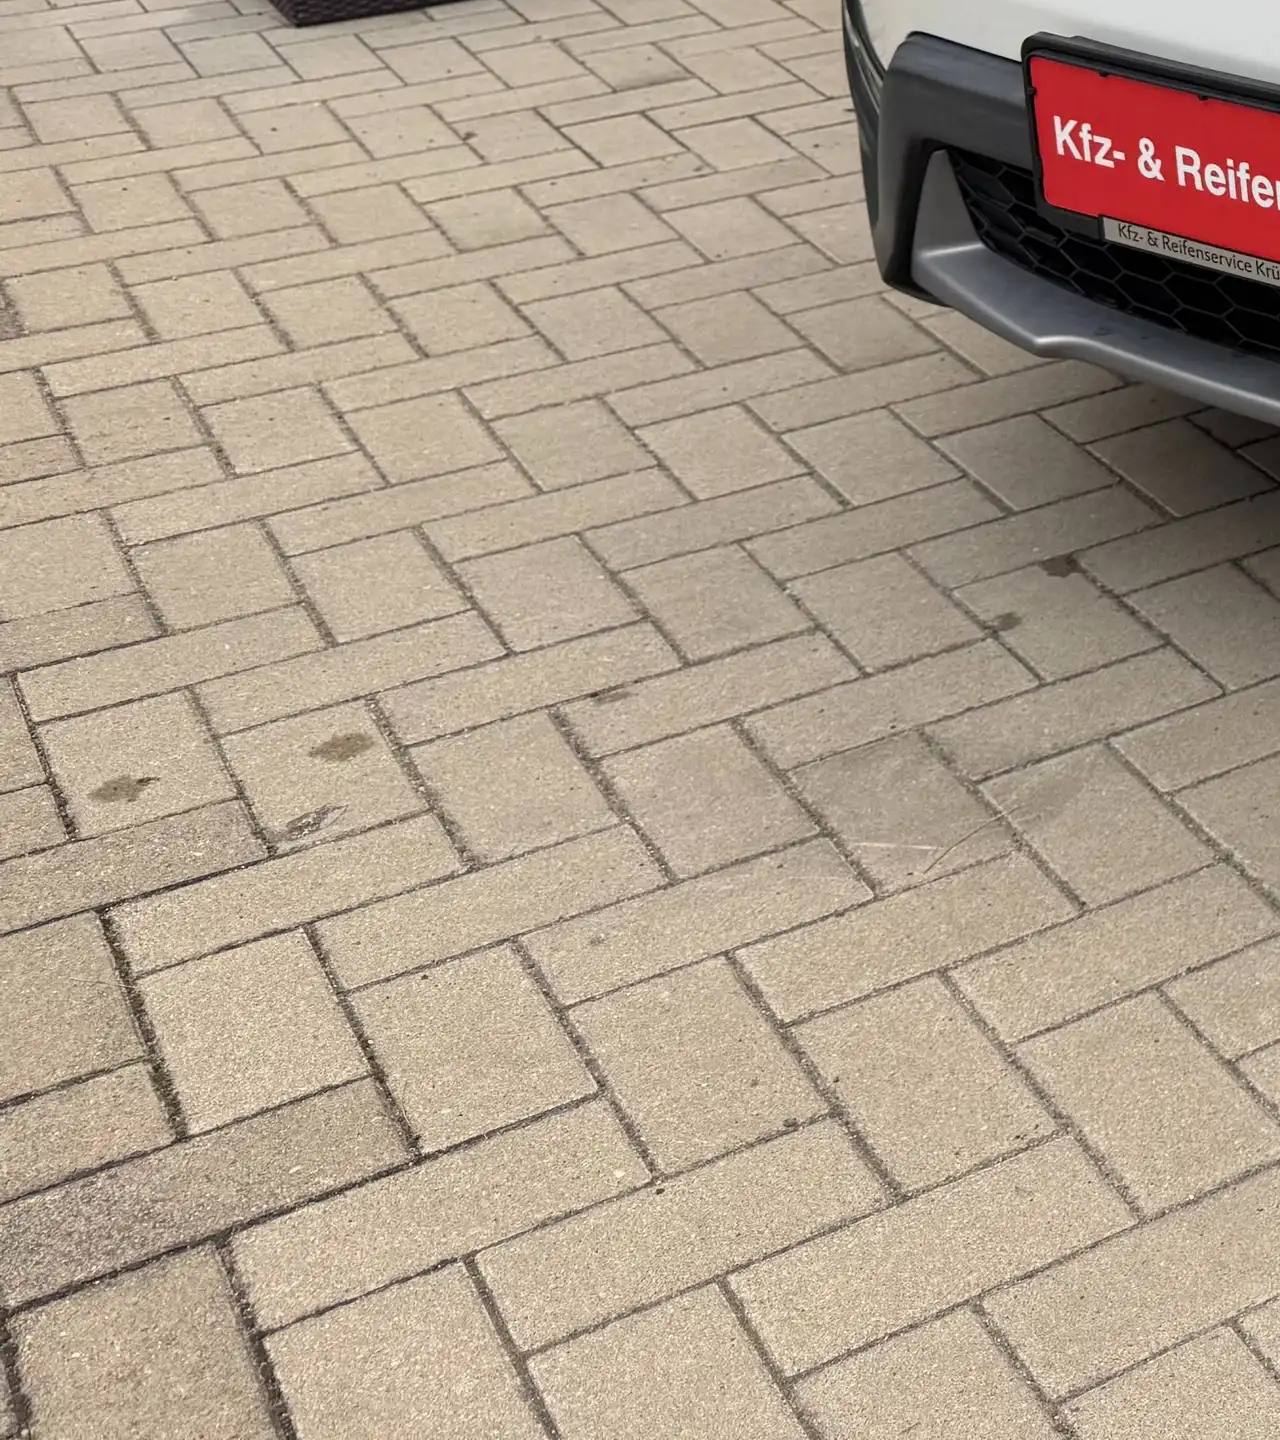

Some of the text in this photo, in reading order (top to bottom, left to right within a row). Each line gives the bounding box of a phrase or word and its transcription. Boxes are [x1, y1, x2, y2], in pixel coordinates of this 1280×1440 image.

[1053, 115, 1126, 168] Kfz-
[1137, 137, 1165, 181] &
[1117, 223, 1144, 243] Kfz-
[1147, 231, 1160, 248] &
[1162, 235, 1253, 273] Reifenservice
